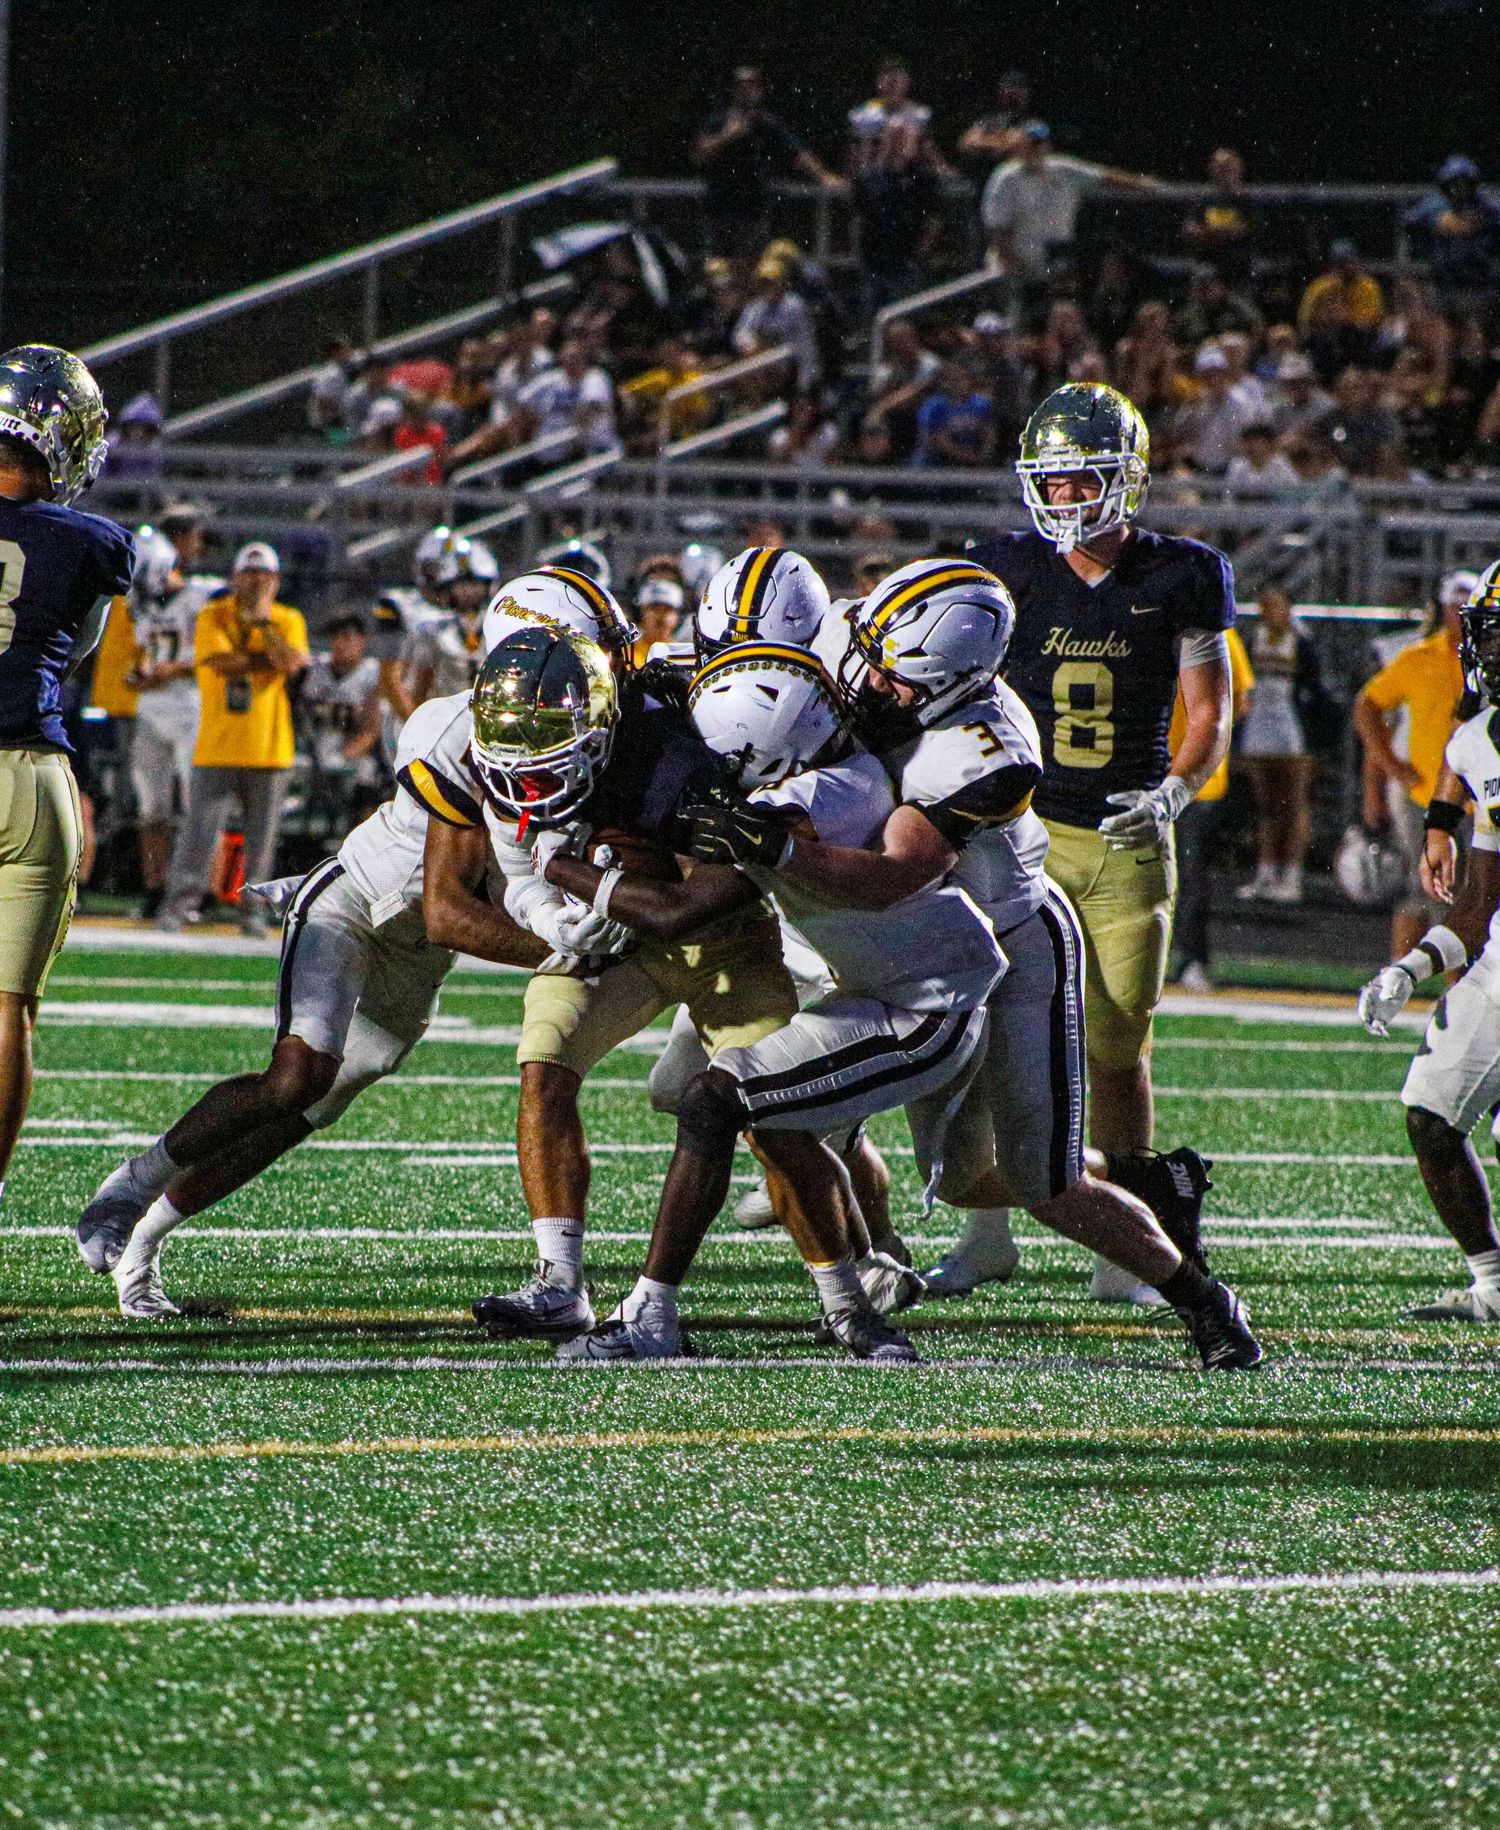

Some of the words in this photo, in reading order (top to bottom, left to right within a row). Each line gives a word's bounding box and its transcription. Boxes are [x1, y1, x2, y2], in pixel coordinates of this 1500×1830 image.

[1041, 626, 1131, 657] Hawks
[1052, 661, 1114, 768] 8
[962, 720, 1005, 758] 3
[1165, 1160, 1195, 1199] NIKE
